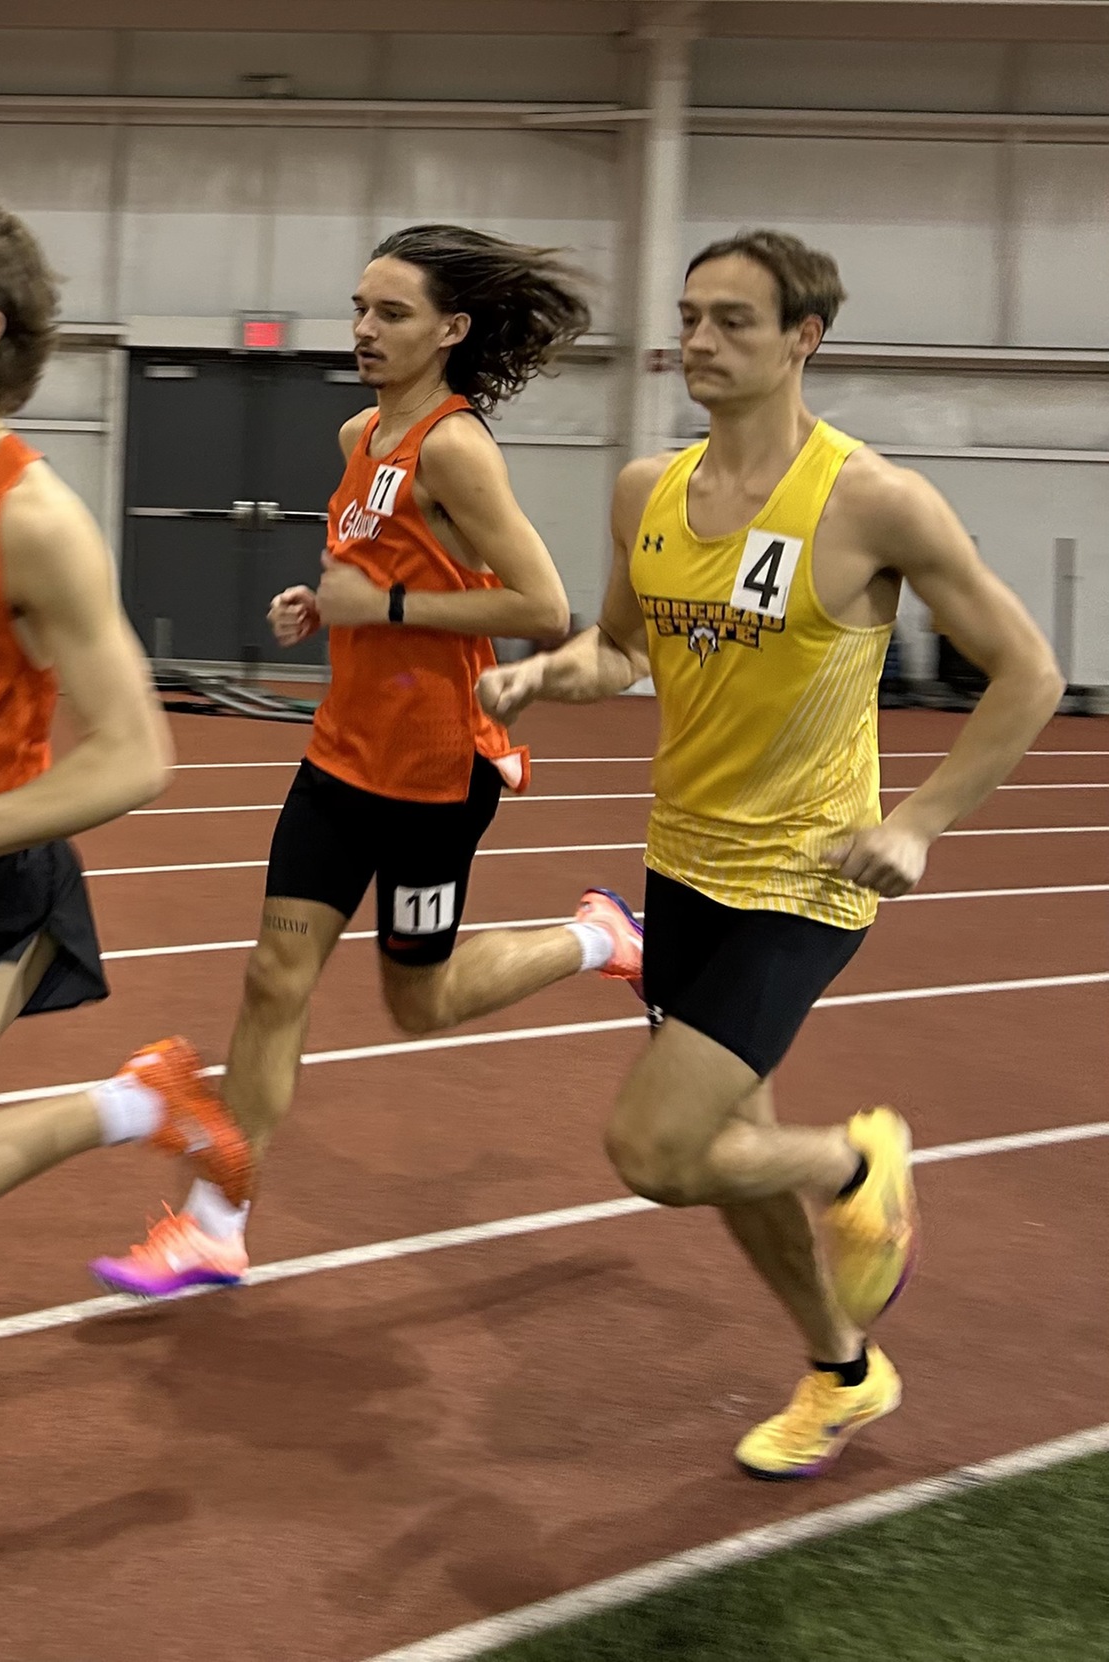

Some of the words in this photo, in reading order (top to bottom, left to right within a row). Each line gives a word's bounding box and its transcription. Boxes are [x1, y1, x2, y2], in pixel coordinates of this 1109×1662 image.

[370, 468, 397, 510] 11
[743, 539, 785, 609] 4
[656, 617, 760, 647] STATE
[405, 888, 442, 933] 11
